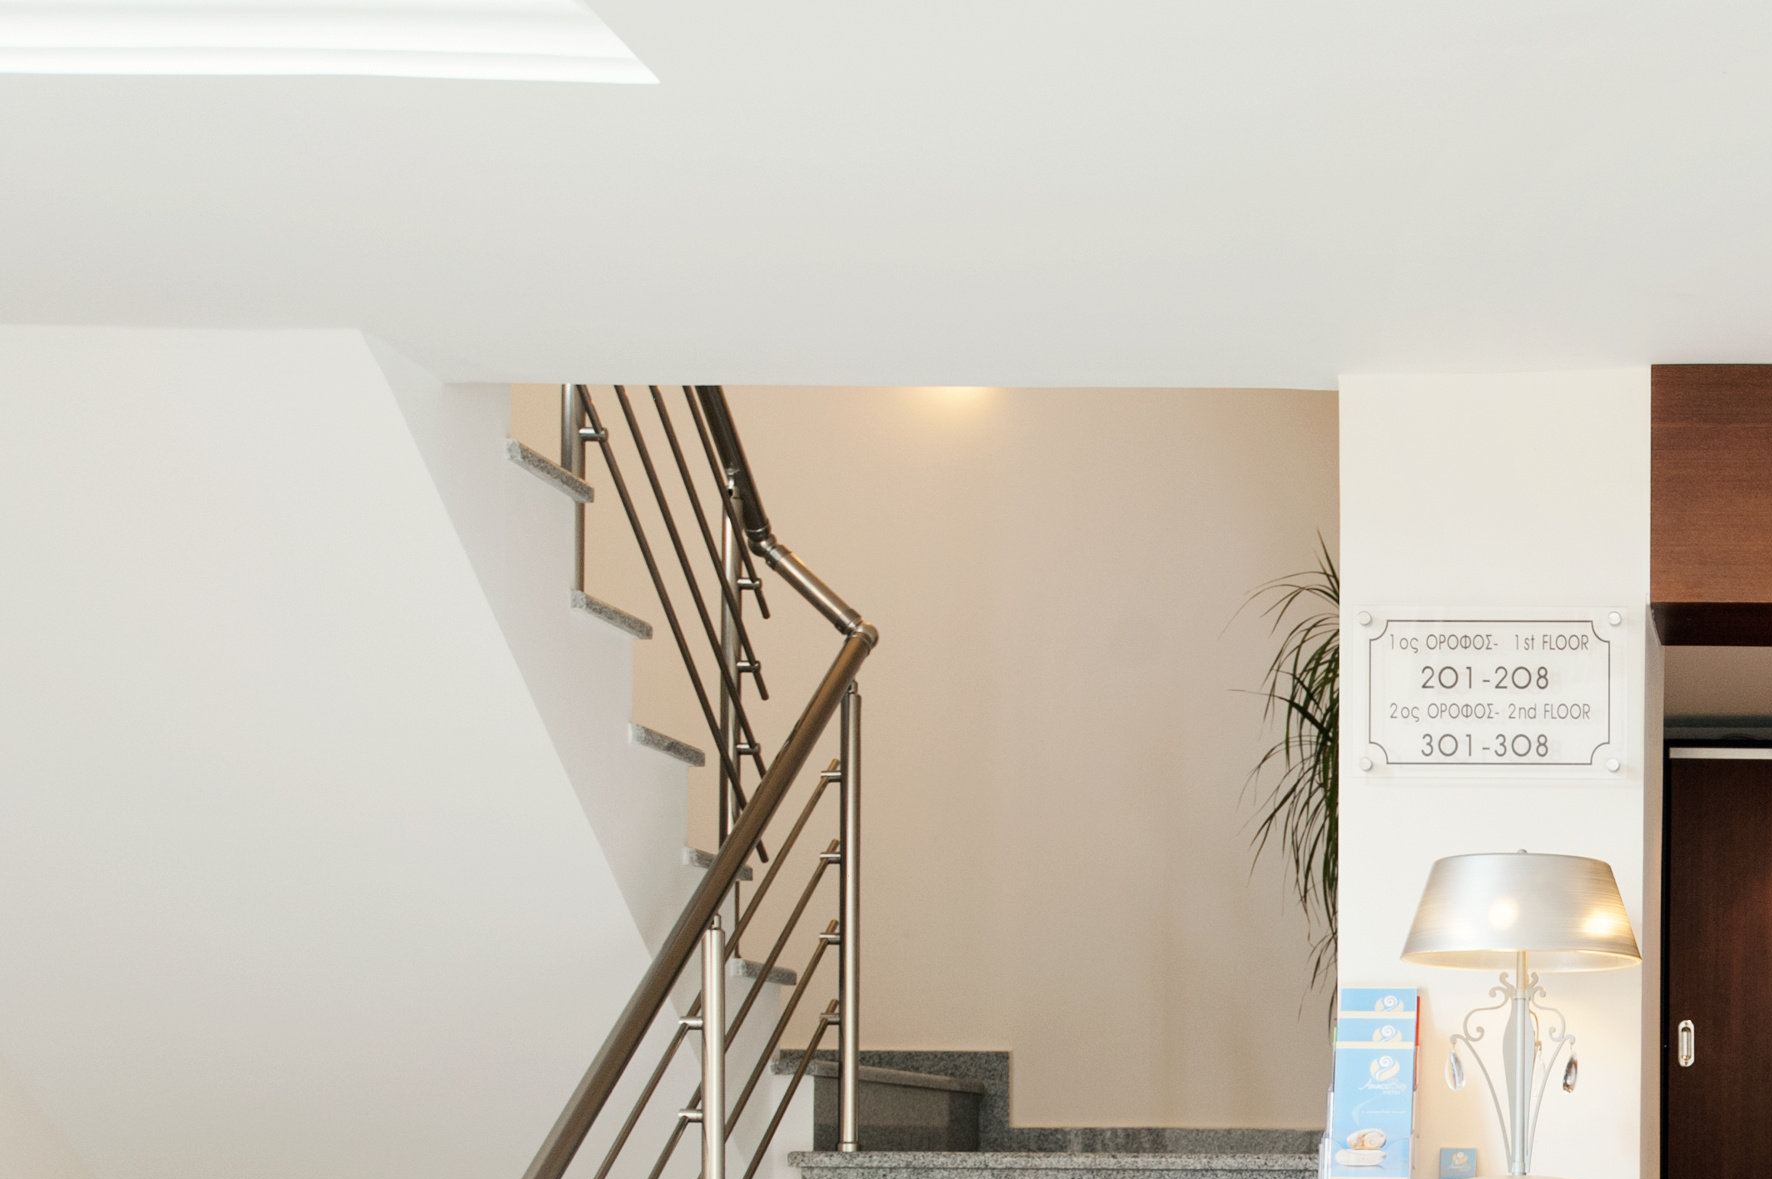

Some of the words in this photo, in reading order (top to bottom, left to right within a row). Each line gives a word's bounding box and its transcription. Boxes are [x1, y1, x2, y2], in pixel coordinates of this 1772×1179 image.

[1390, 634, 1419, 653] 1ος
[1515, 634, 1535, 651] 1st
[1542, 634, 1589, 651] FLOOR
[1421, 666, 1549, 690] 201-208
[1390, 702, 1419, 722] 2ος
[1508, 703, 1536, 720] 2nd
[1543, 703, 1591, 720] FLOOR
[1421, 734, 1549, 757] 301-308
